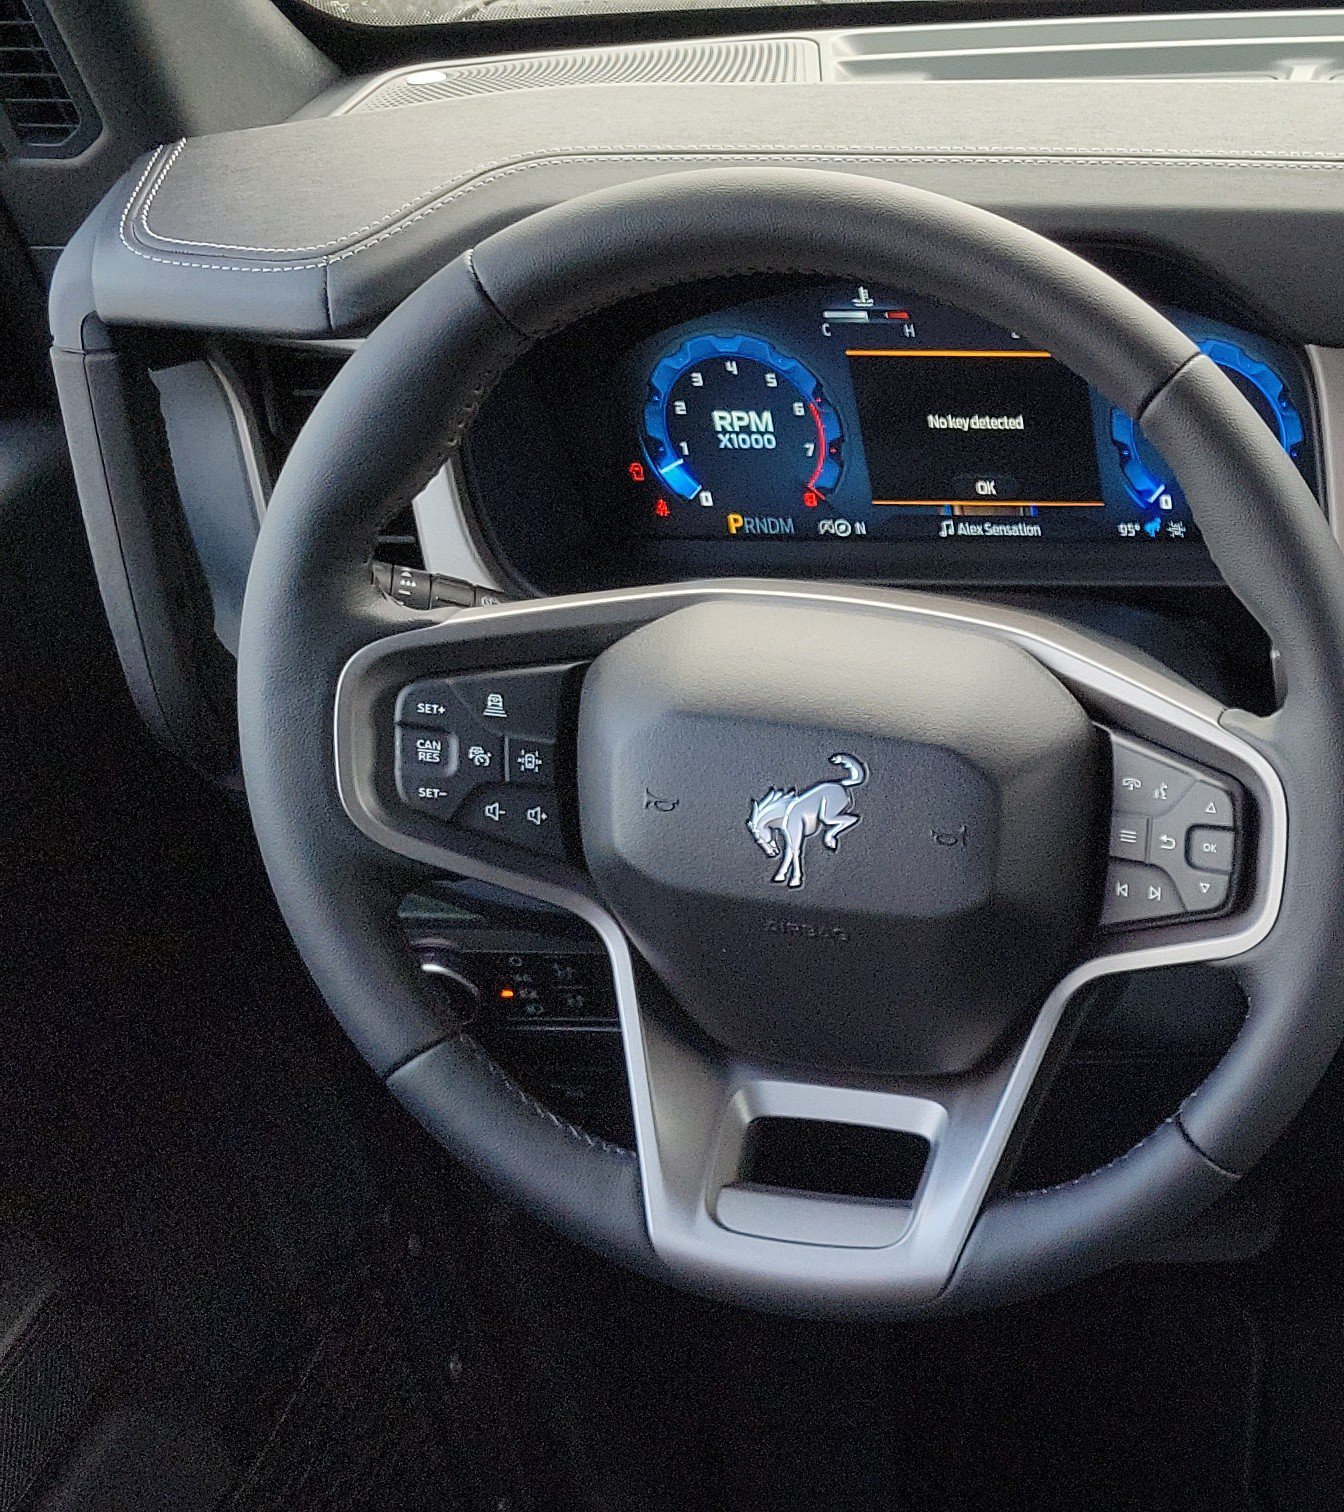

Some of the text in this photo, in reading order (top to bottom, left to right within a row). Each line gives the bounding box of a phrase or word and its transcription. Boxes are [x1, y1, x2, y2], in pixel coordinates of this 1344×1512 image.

[822, 323, 831, 336] C
[903, 324, 915, 337] H
[725, 361, 738, 375] 4
[691, 372, 703, 386] 3
[765, 373, 777, 387] 5
[674, 401, 686, 415] 2
[792, 402, 804, 416] 6
[712, 410, 774, 432] RPM
[927, 414, 1024, 431] No key detected
[680, 441, 689, 455] 1
[718, 433, 776, 449] X1000
[804, 443, 815, 457] 7
[975, 480, 997, 495] OK
[700, 491, 713, 506] 0
[957, 522, 1041, 537] Alex Sensation
[417, 703, 446, 714] SET+
[416, 740, 441, 750] CAN
[418, 752, 441, 762] RES
[1203, 843, 1217, 853] OK
